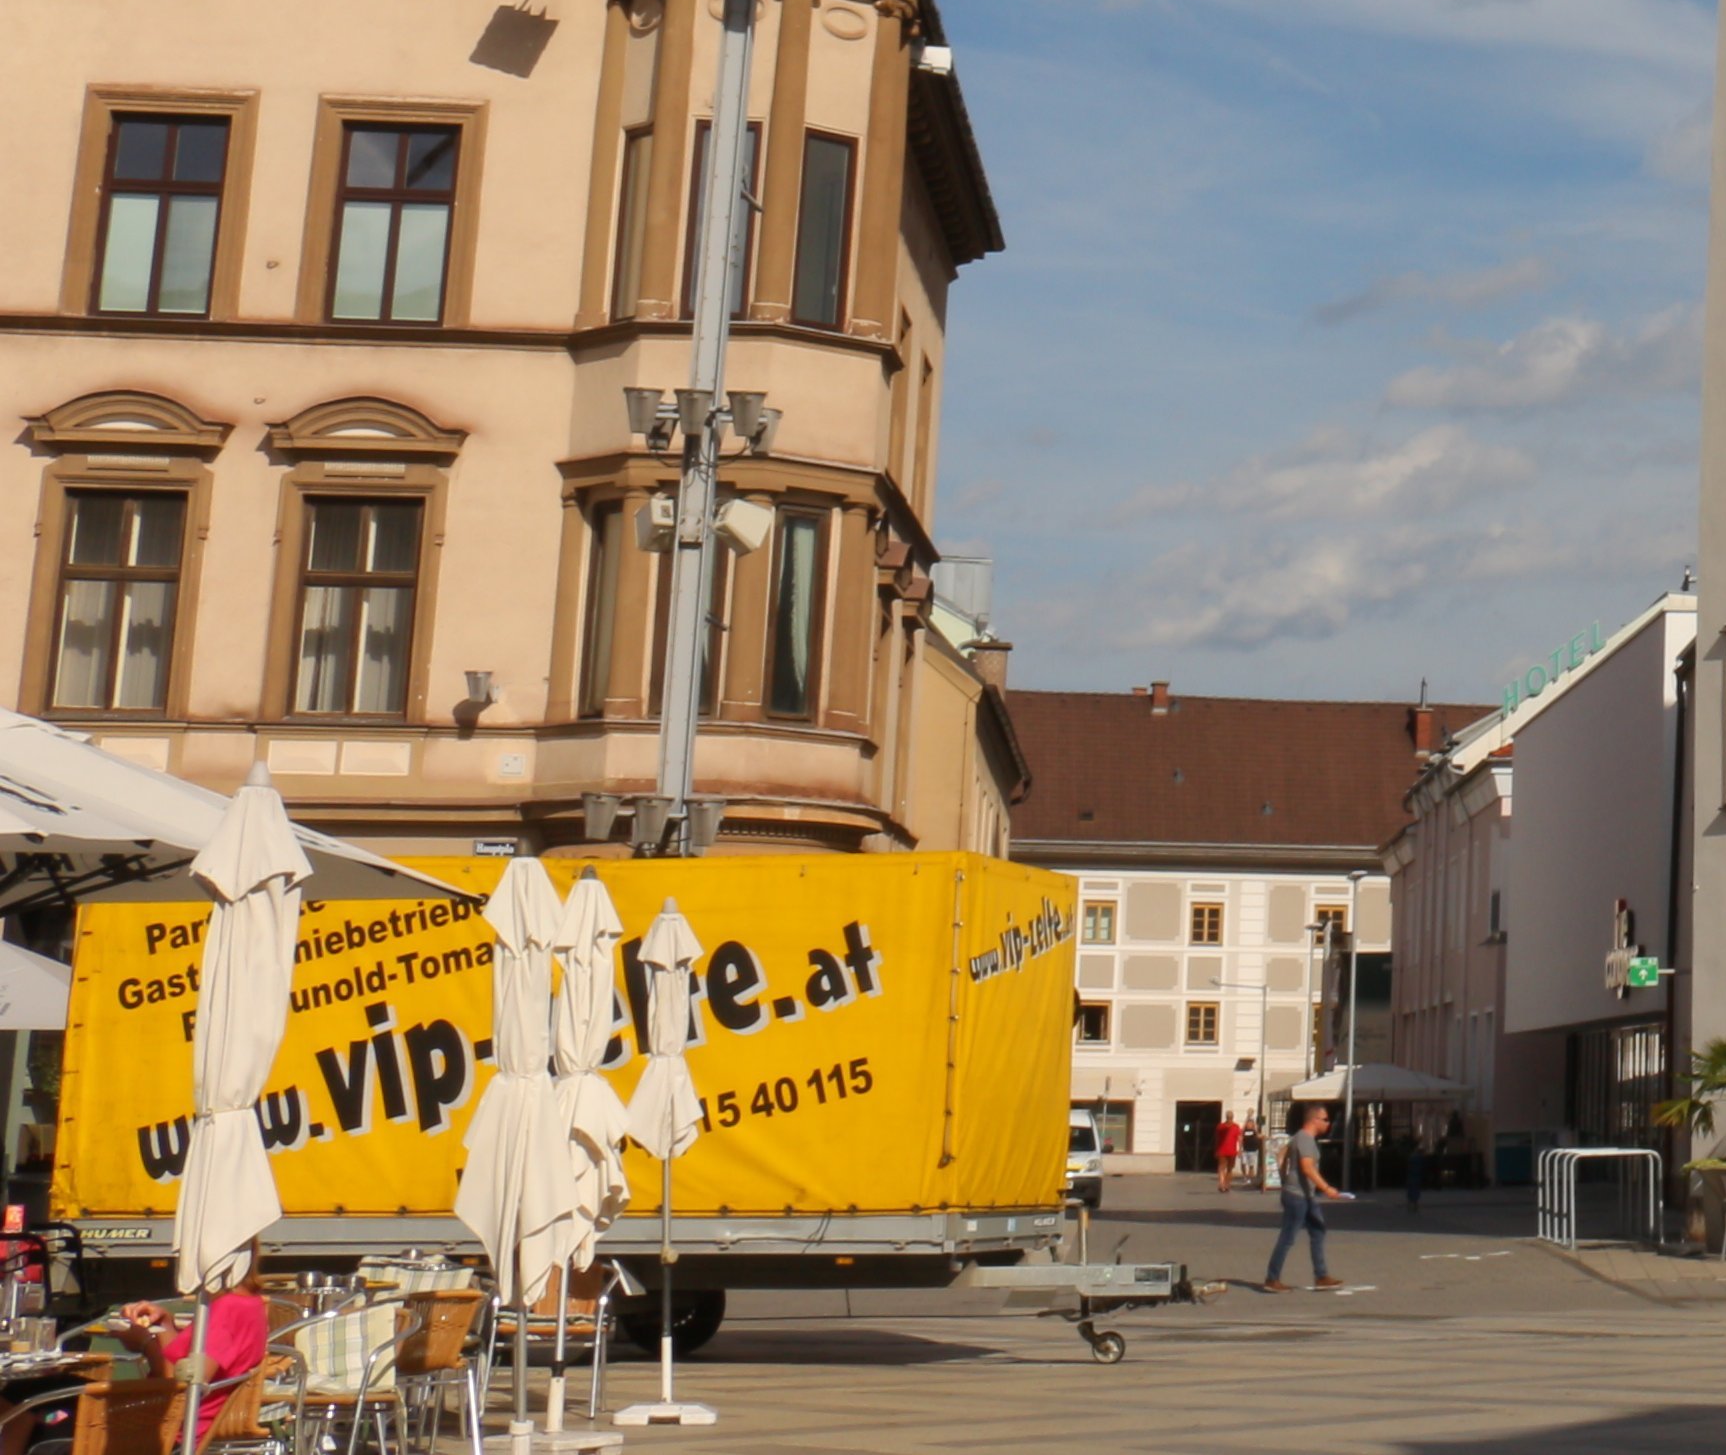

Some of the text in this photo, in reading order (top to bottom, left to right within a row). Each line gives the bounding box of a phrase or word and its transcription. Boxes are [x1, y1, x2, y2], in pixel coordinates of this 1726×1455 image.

[750, 1076, 799, 1118] 40
[806, 1056, 873, 1106] 115
[80, 1227, 150, 1239] HUMER
